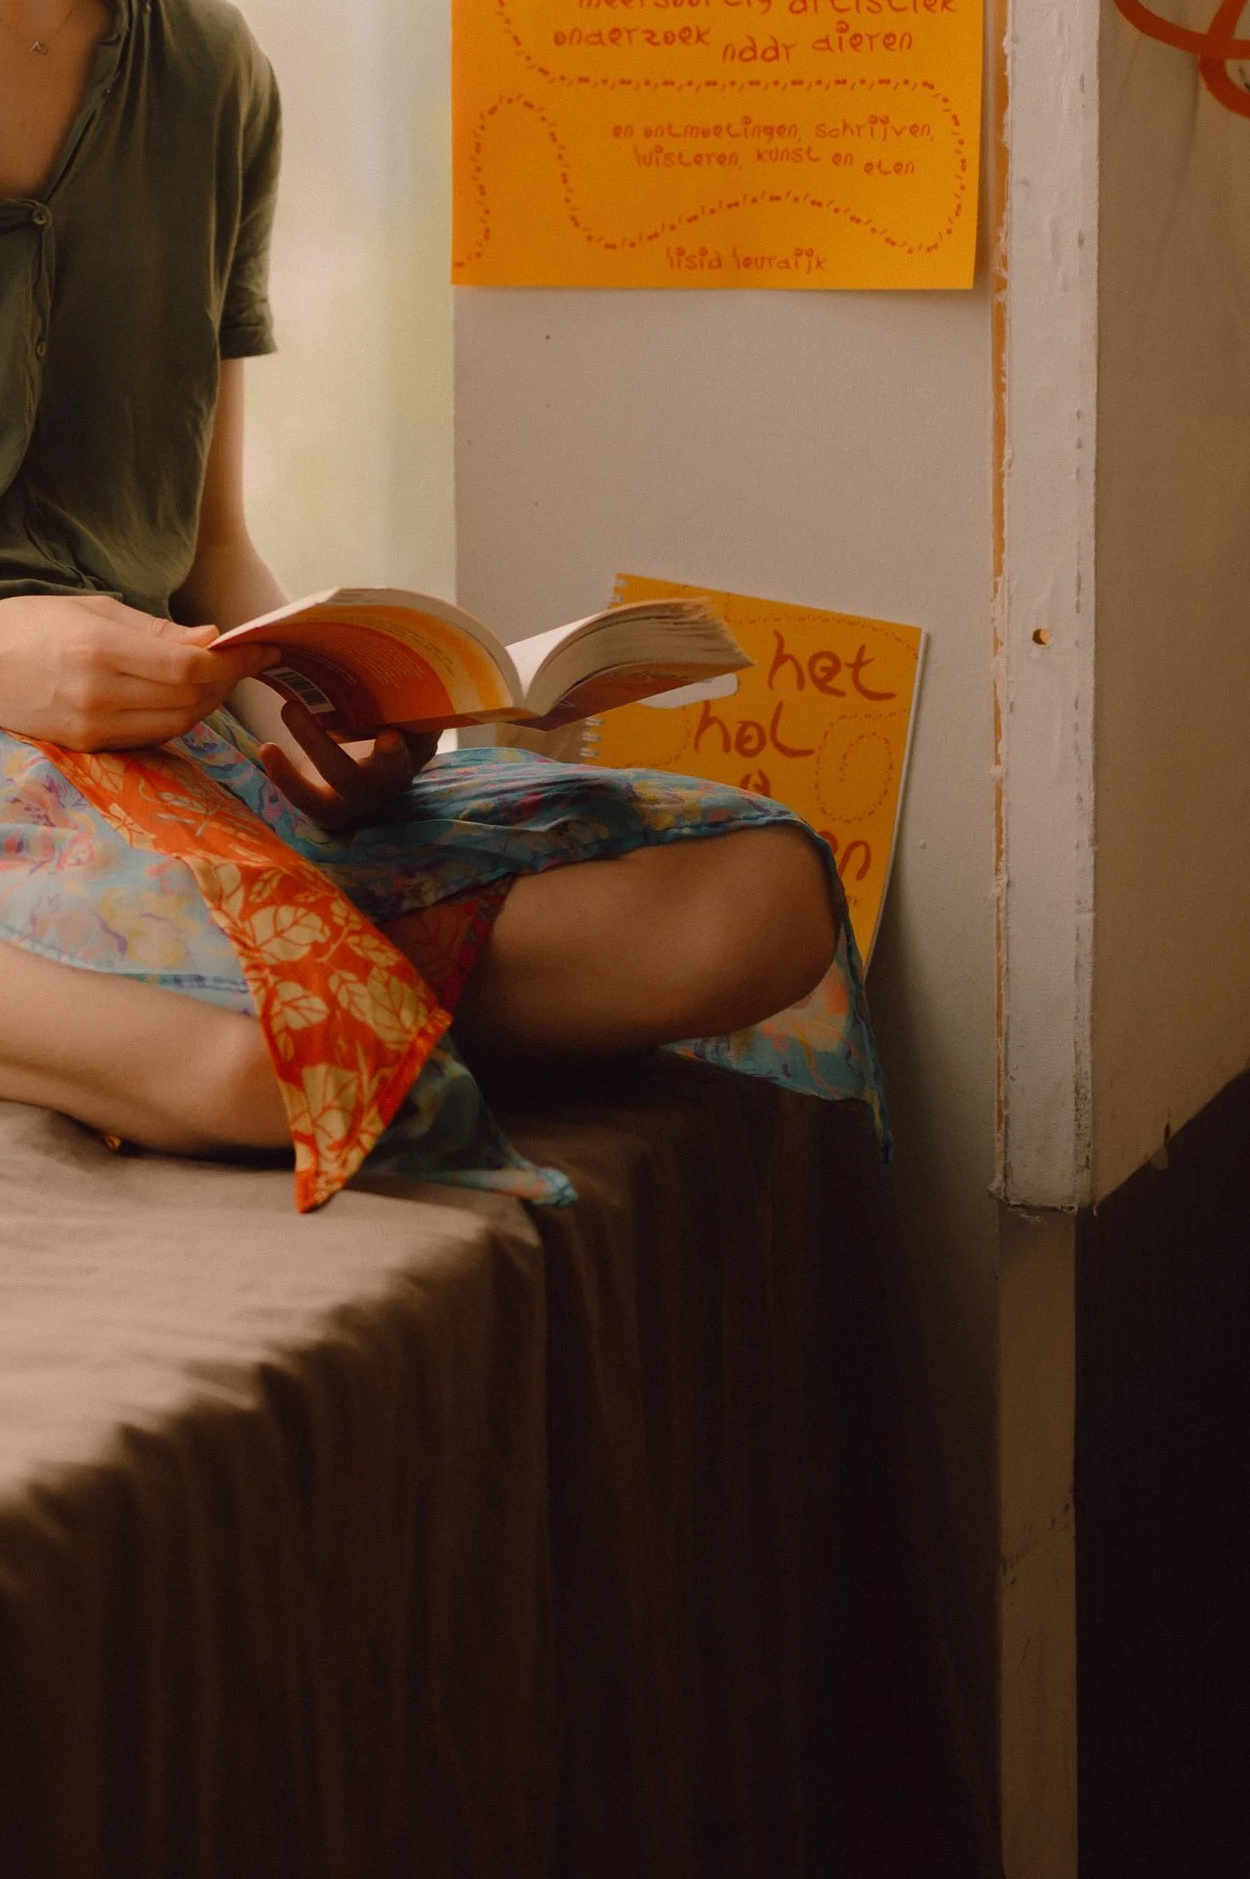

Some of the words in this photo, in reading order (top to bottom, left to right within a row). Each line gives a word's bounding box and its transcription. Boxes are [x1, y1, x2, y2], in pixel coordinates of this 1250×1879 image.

[552, 25, 711, 47] onderzoek
[721, 34, 798, 63] naar
[811, 20, 913, 53] dieren
[756, 146, 822, 163] kunst
[831, 152, 854, 167] en
[766, 628, 898, 702] het
[693, 699, 815, 759] hol
